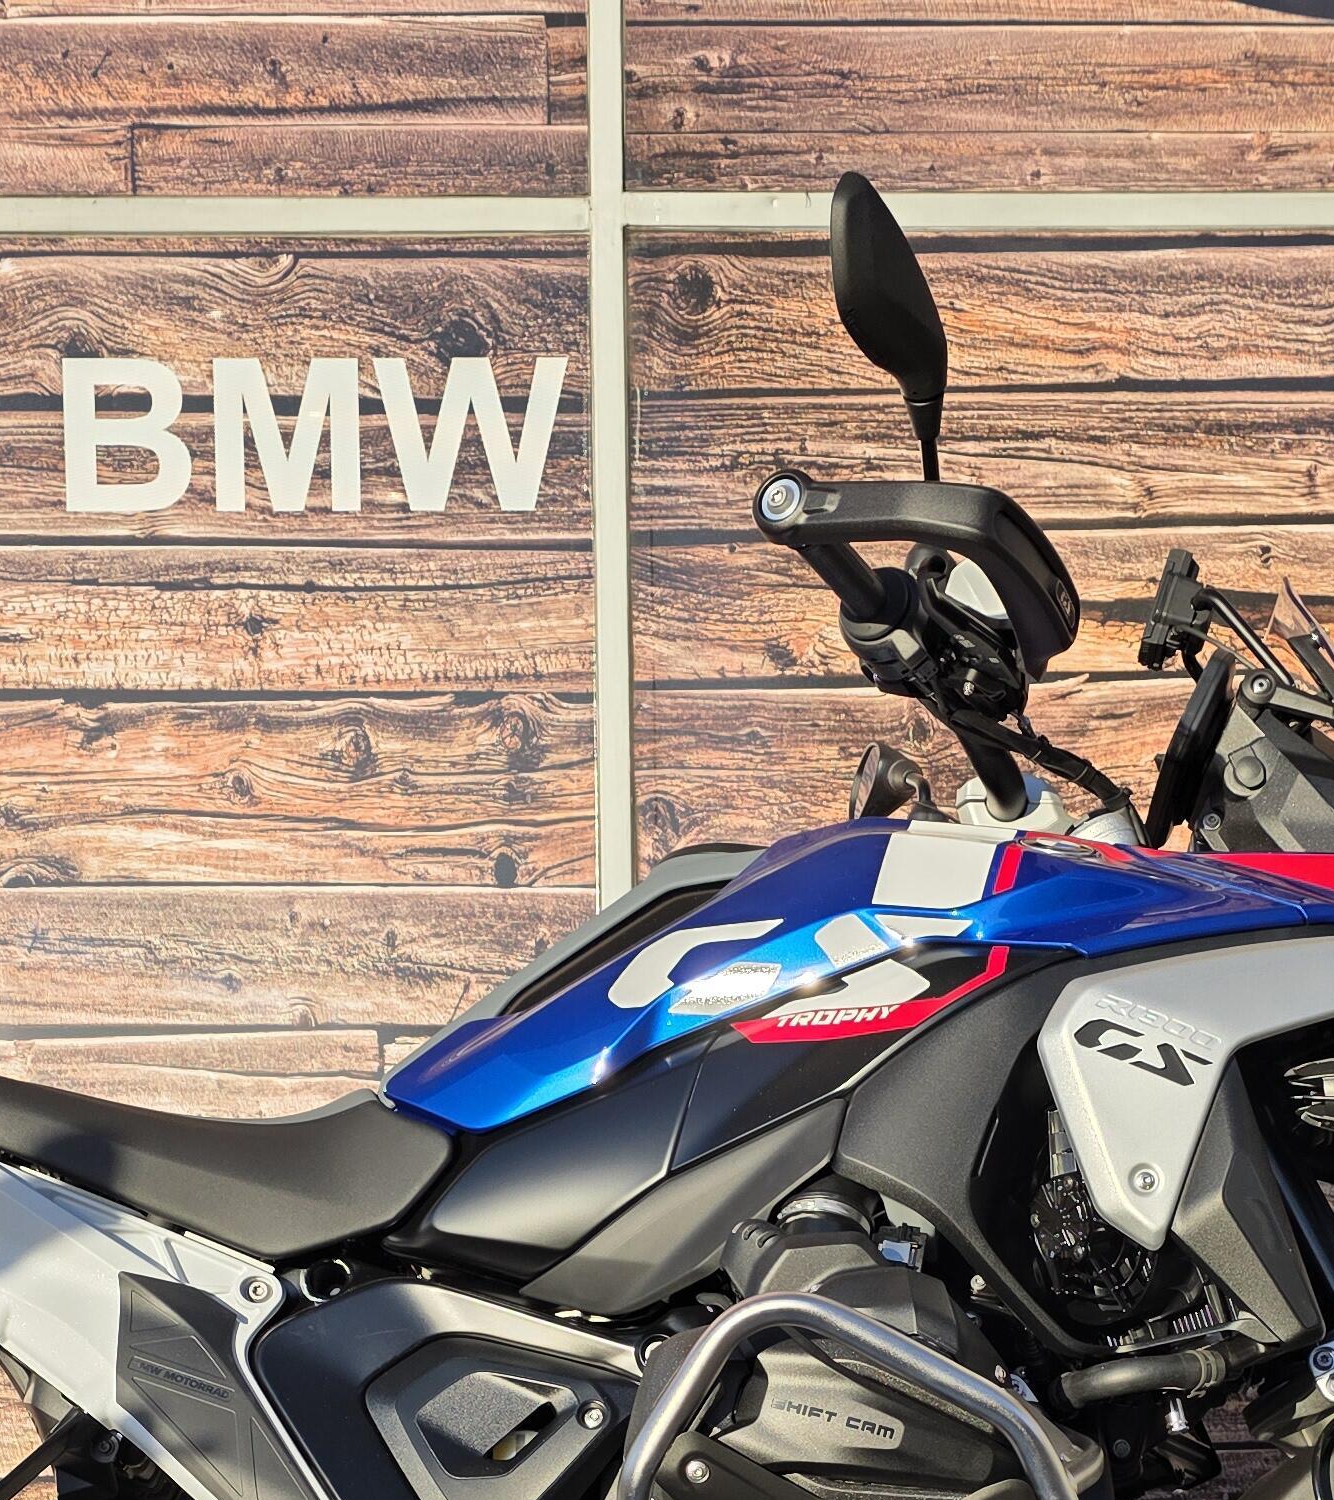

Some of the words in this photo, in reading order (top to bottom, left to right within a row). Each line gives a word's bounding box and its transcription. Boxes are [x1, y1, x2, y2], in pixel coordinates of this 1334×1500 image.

[62, 356, 569, 513] BMW
[776, 1004, 901, 1028] TROPHY
[1074, 1019, 1213, 1086] GS
[163, 1371, 230, 1399] MOTORRAD
[771, 1399, 838, 1422] SHIFT
[845, 1416, 895, 1439] CAM
